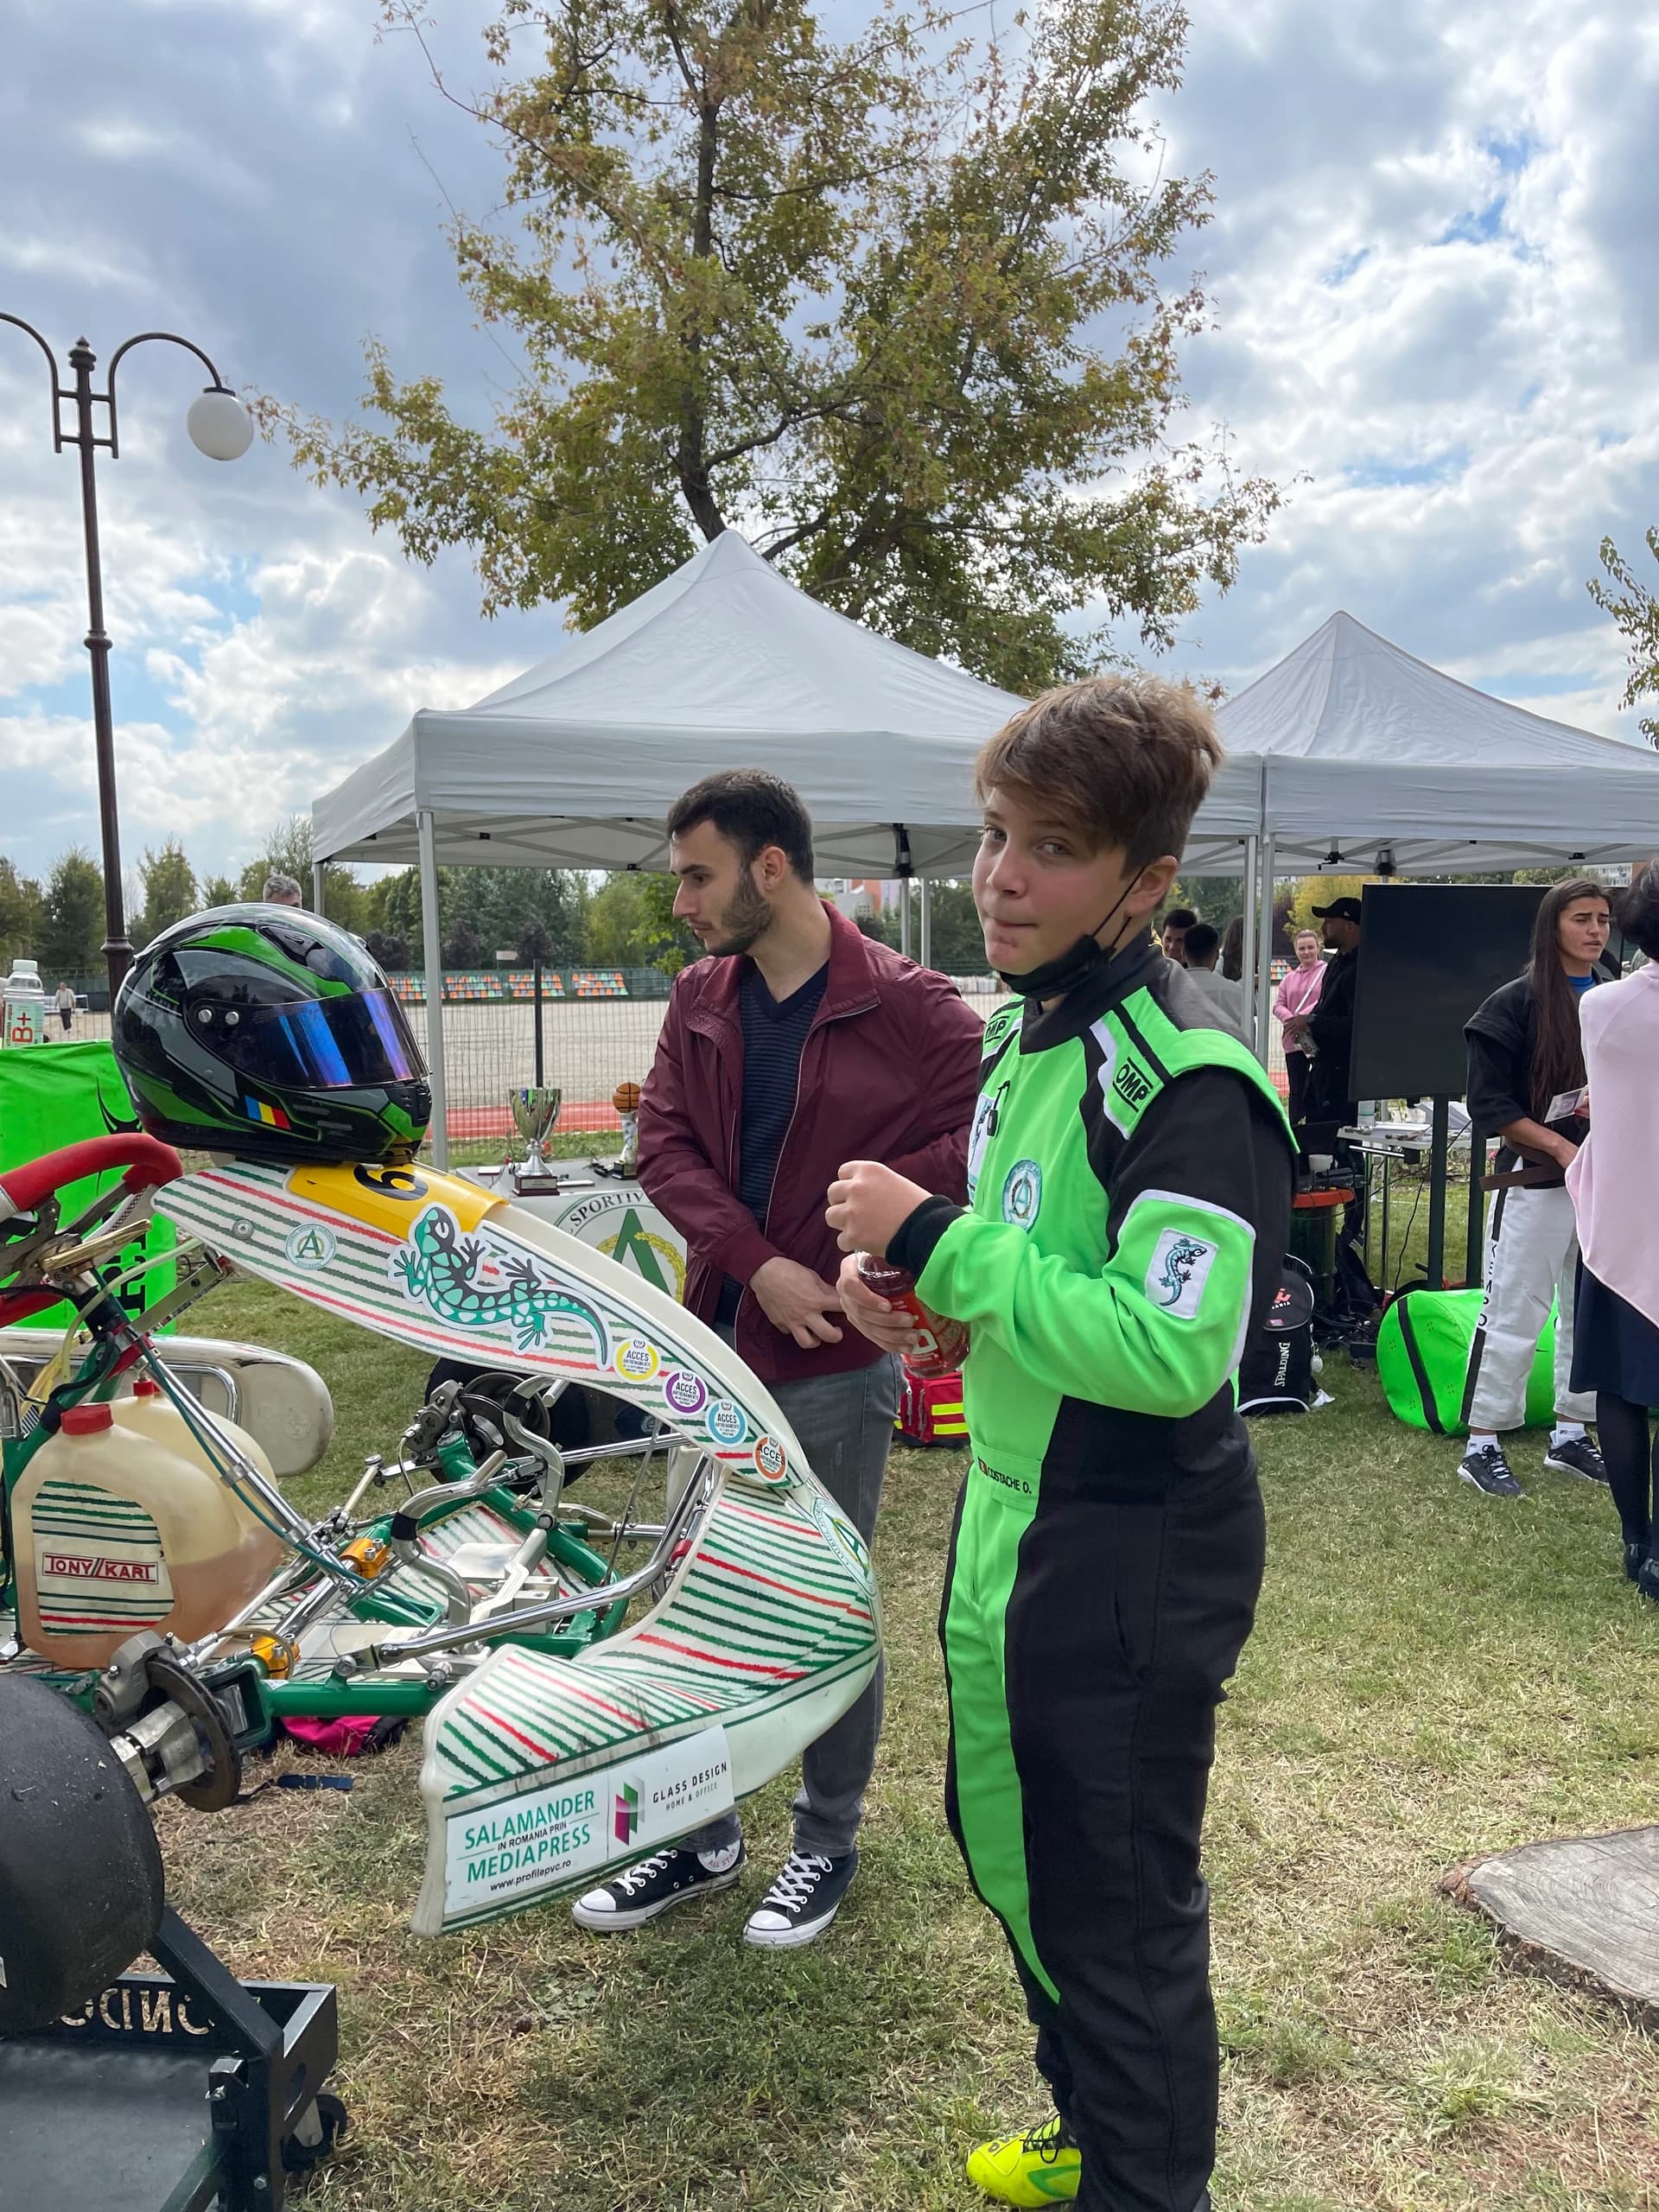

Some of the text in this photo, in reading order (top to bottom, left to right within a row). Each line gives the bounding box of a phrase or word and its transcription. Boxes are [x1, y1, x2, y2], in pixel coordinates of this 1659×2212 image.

[11, 1012, 34, 1043] B+
[985, 1020, 1007, 1039] MP
[1116, 1063, 1148, 1103] OMP
[353, 1163, 429, 1202] 6
[296, 1229, 325, 1259] A
[626, 1350, 650, 1362] ACCES
[1274, 1341, 1291, 1388] SPALDING
[676, 1382, 697, 1395] ACCES
[717, 1413, 738, 1424] ACCES
[45, 1555, 156, 1580] TONY KART
[652, 1761, 727, 1803] GLASS DESIGN
[665, 1796, 685, 1811] HOME
[695, 1782, 717, 1798] OFFICE
[464, 1789, 595, 1850] SALAMANDER
[497, 1821, 568, 1852] IN ROMANIA PRIN
[467, 1824, 591, 1883] MEDIAPRESS
[490, 1859, 572, 1892] www.profilepvc.ro
